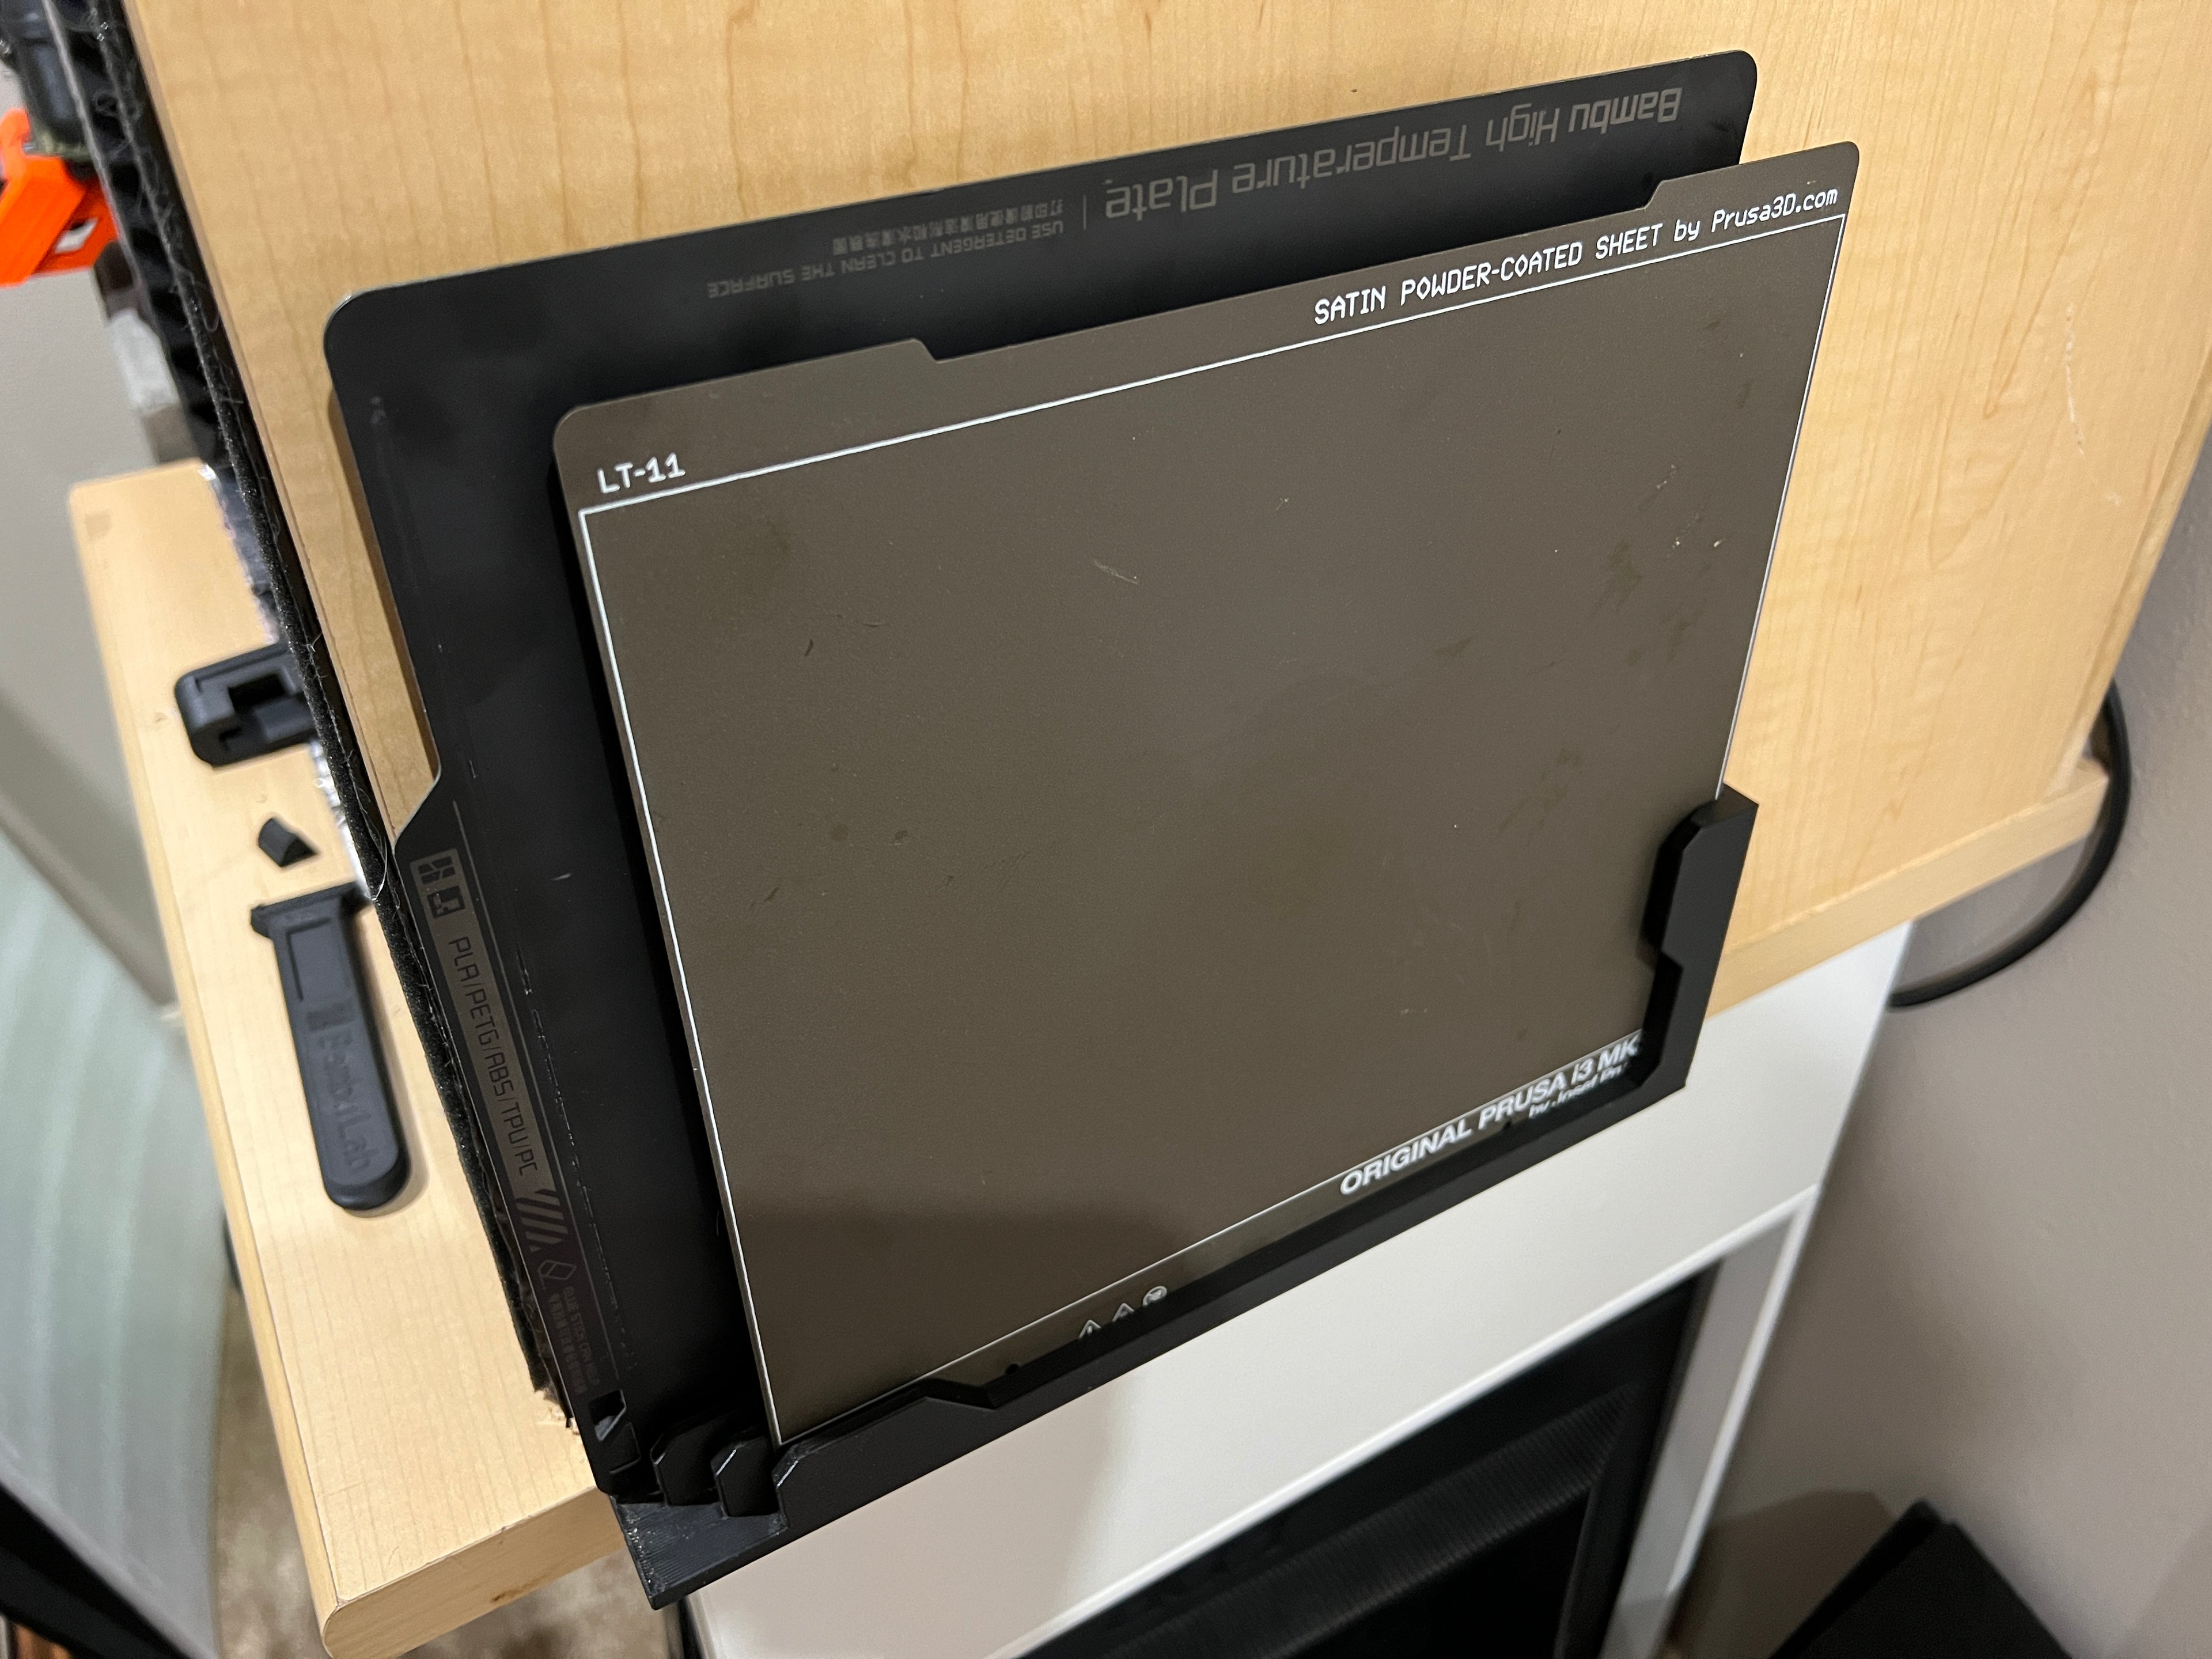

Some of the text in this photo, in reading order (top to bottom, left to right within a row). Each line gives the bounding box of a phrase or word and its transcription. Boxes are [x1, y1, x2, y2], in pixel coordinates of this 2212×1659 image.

[1106, 87, 1683, 221] Bambu High Temperature Plate
[707, 221, 1063, 298] USE DETERGENT TO CLEAN THE SURFACE
[1314, 187, 1838, 325] SATIN POWDER-COATED SHEET by Prusa3D.com
[597, 452, 685, 494] LT-11
[449, 936, 537, 1177] PLA/PETG/ABS/TPU/PC
[1340, 1119, 1472, 1195] ORIGINAL
[1479, 1073, 1566, 1130] PRUSA
